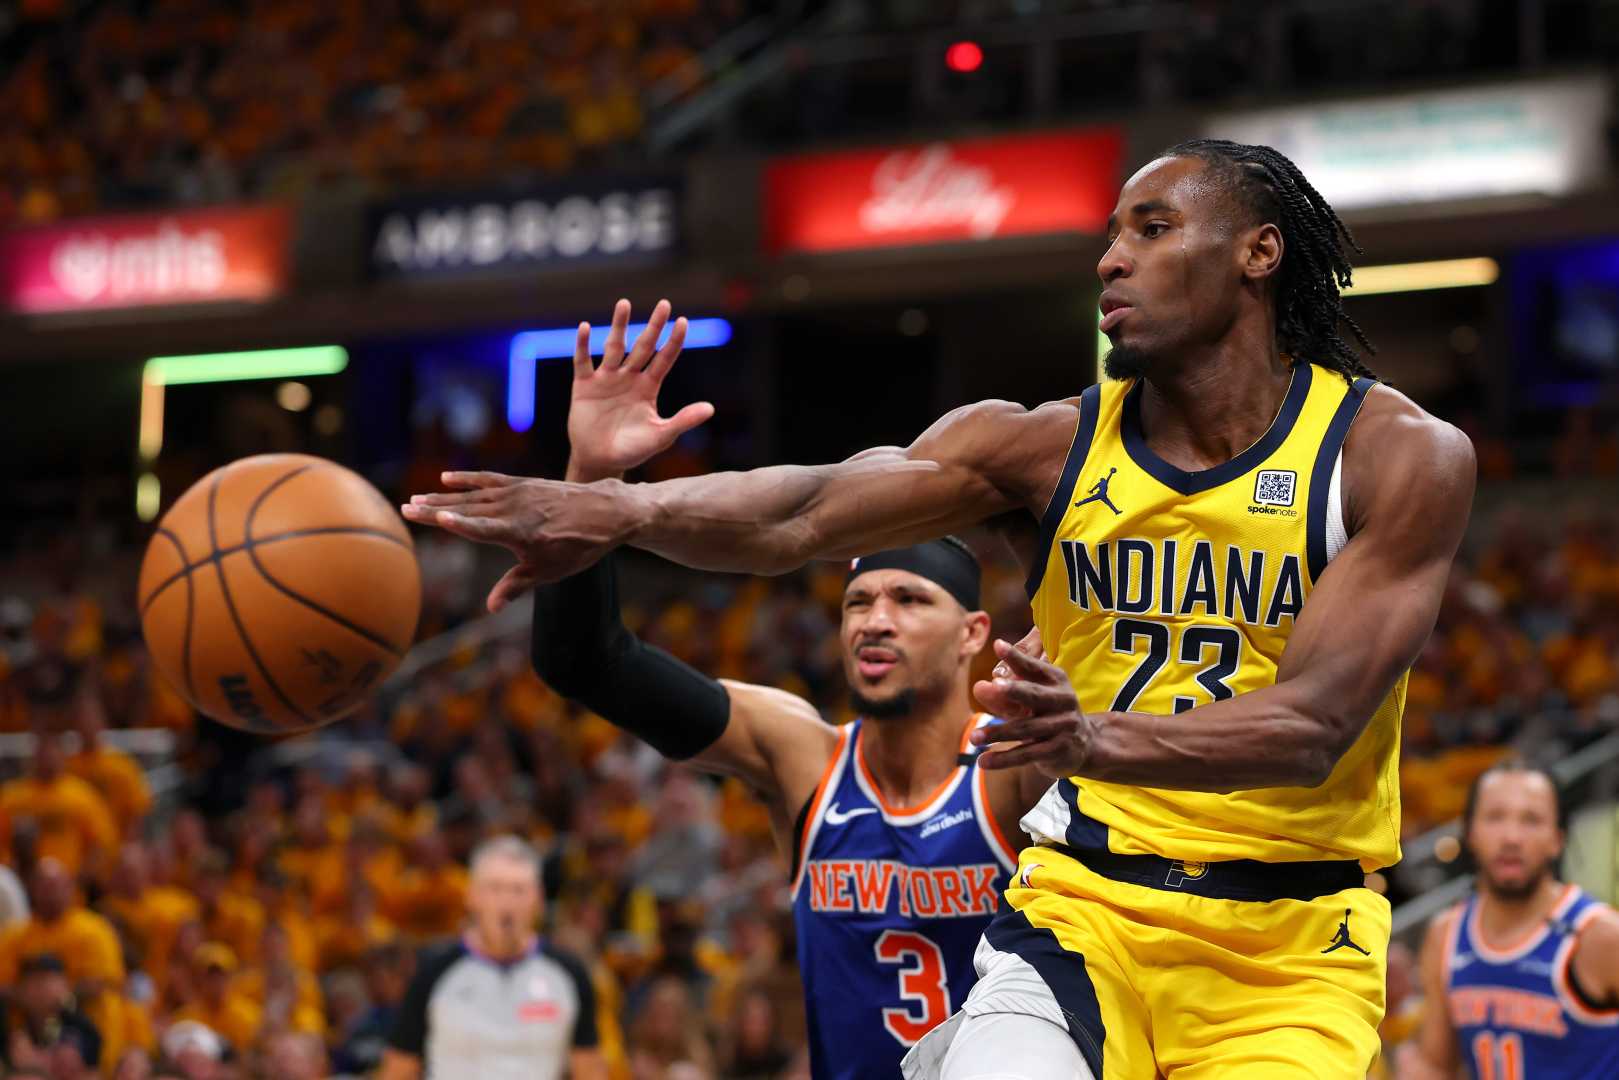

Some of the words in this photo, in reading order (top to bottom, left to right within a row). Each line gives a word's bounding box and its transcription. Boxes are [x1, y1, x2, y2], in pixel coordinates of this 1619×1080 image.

[374, 191, 671, 266] AMBROSE
[1247, 505, 1297, 517] spokenote
[1060, 537, 1305, 628] INDIANA
[1109, 617, 1242, 715] 23
[808, 860, 894, 913] NEW
[895, 864, 999, 918] YORK
[874, 929, 952, 1048] 3
